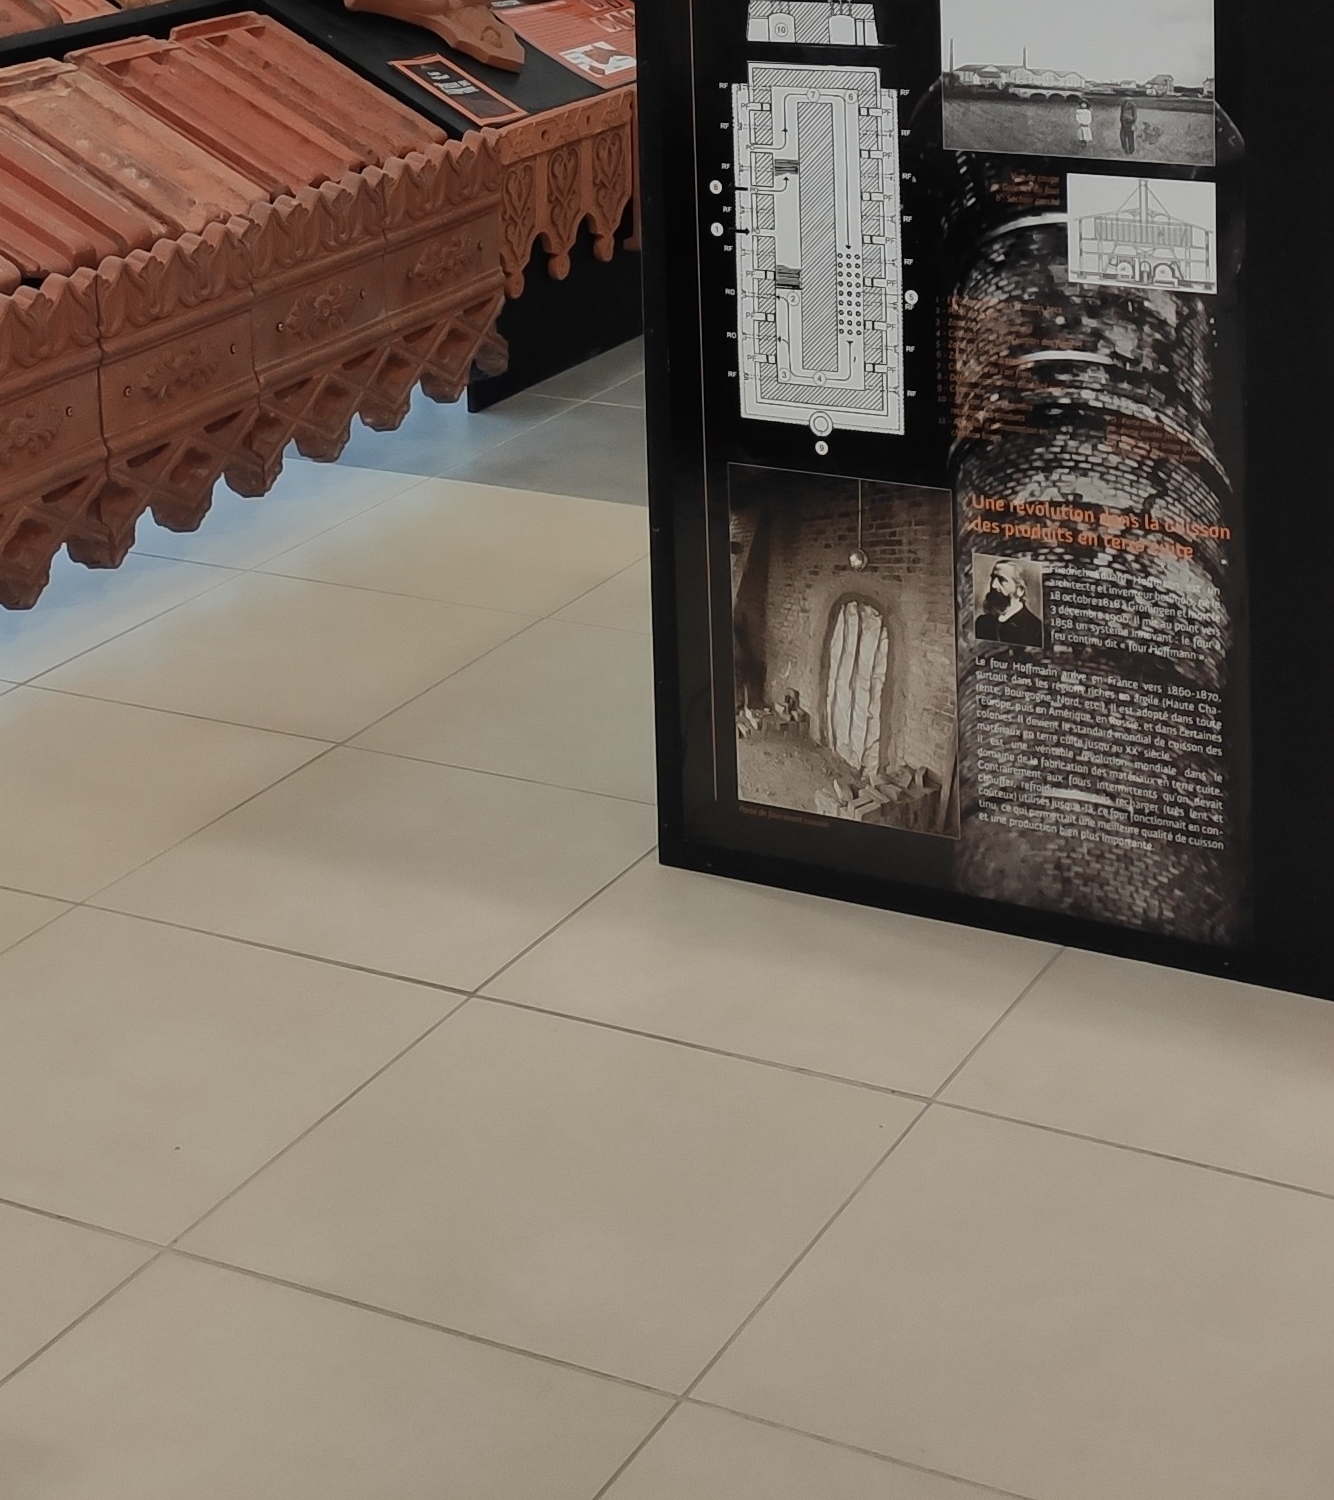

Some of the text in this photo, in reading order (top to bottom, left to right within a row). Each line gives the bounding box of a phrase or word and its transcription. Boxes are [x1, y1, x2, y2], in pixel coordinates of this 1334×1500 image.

[972, 494, 1004, 512] Une
[1144, 515, 1161, 530] la
[971, 517, 1000, 534] des
[1004, 524, 1073, 542] produits
[1078, 533, 1098, 545] en
[974, 656, 985, 666] Le
[989, 658, 1008, 670] four
[1012, 661, 1057, 677] Hoffmann
[1140, 683, 1162, 693] vers
